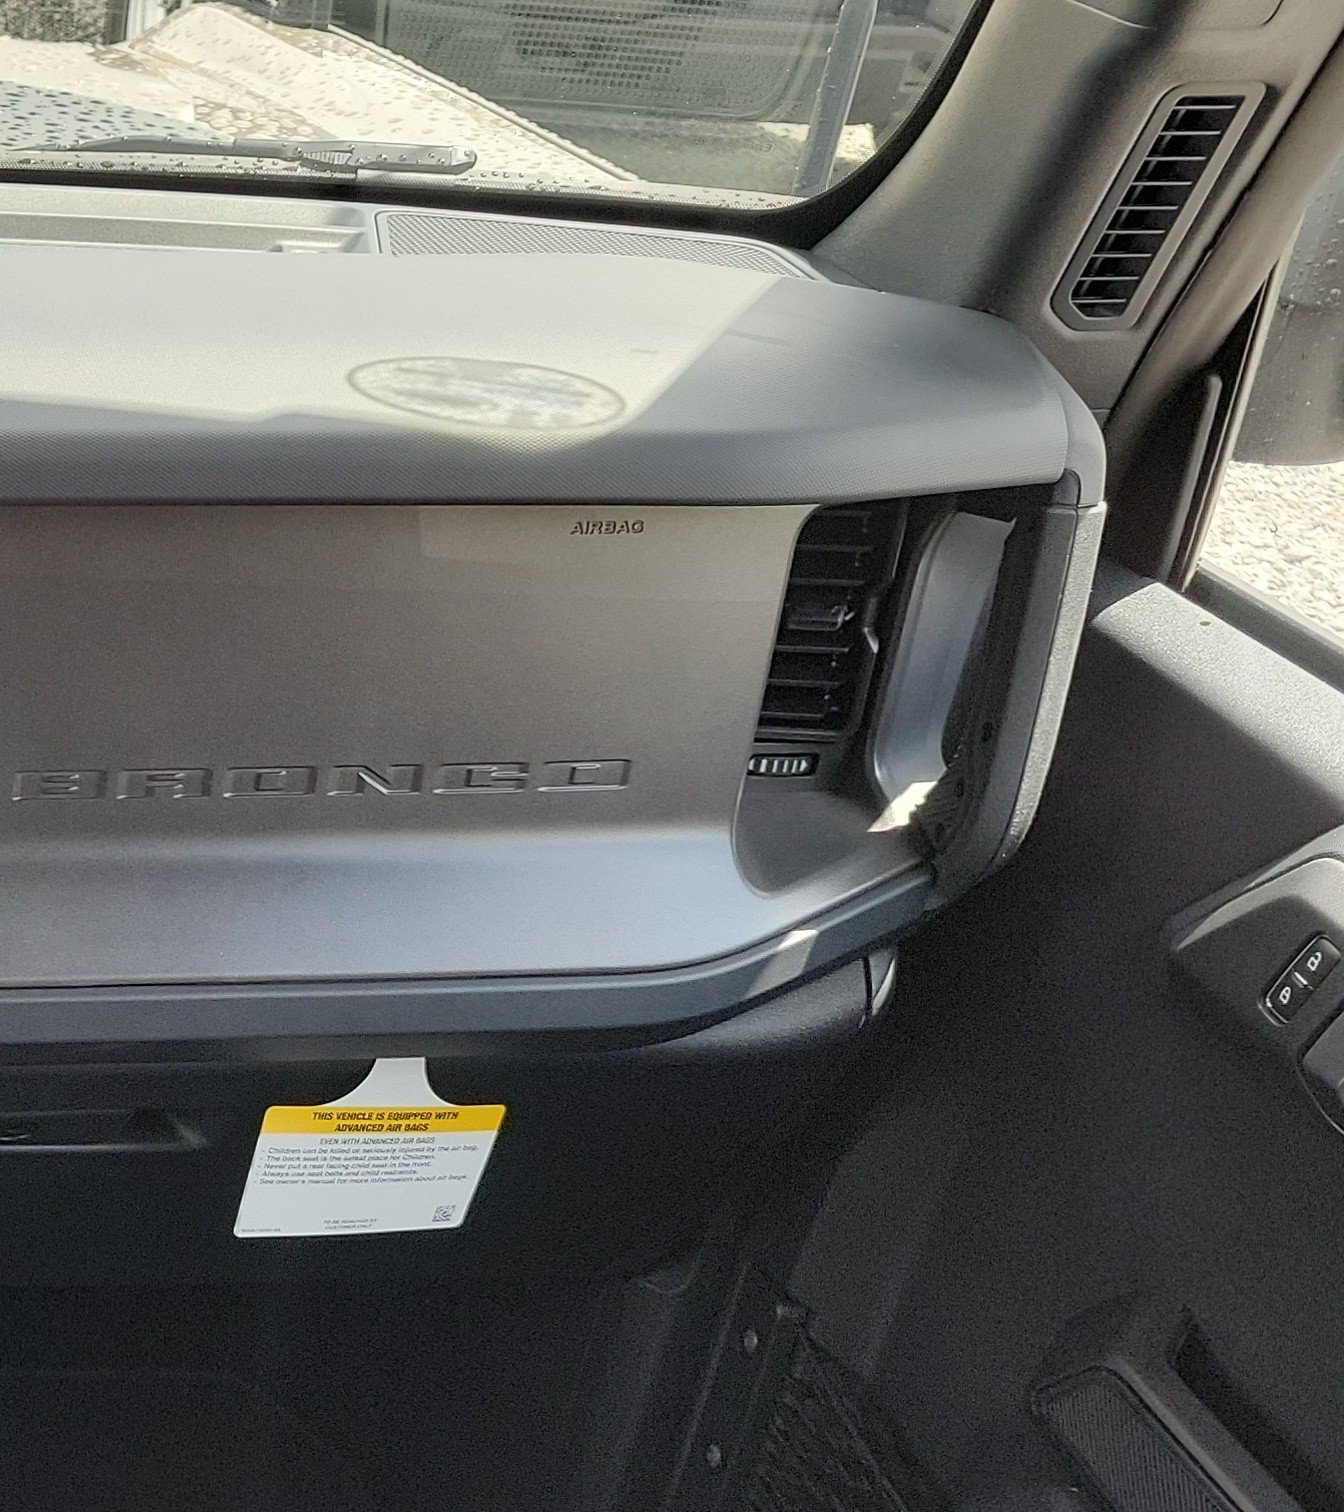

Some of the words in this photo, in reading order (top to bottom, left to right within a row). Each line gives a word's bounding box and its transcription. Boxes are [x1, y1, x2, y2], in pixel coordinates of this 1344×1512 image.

[569, 519, 646, 536] AIRBAG
[11, 758, 632, 802] BRONCO
[313, 1112, 334, 1121] THIS
[337, 1112, 374, 1121] VEHICLE
[375, 1112, 385, 1121] IS
[387, 1112, 433, 1120] EQUIPPED
[435, 1111, 459, 1120] WITH
[334, 1124, 384, 1132] ADVANCED
[386, 1124, 402, 1132] AIR
[404, 1123, 429, 1132] BAGS
